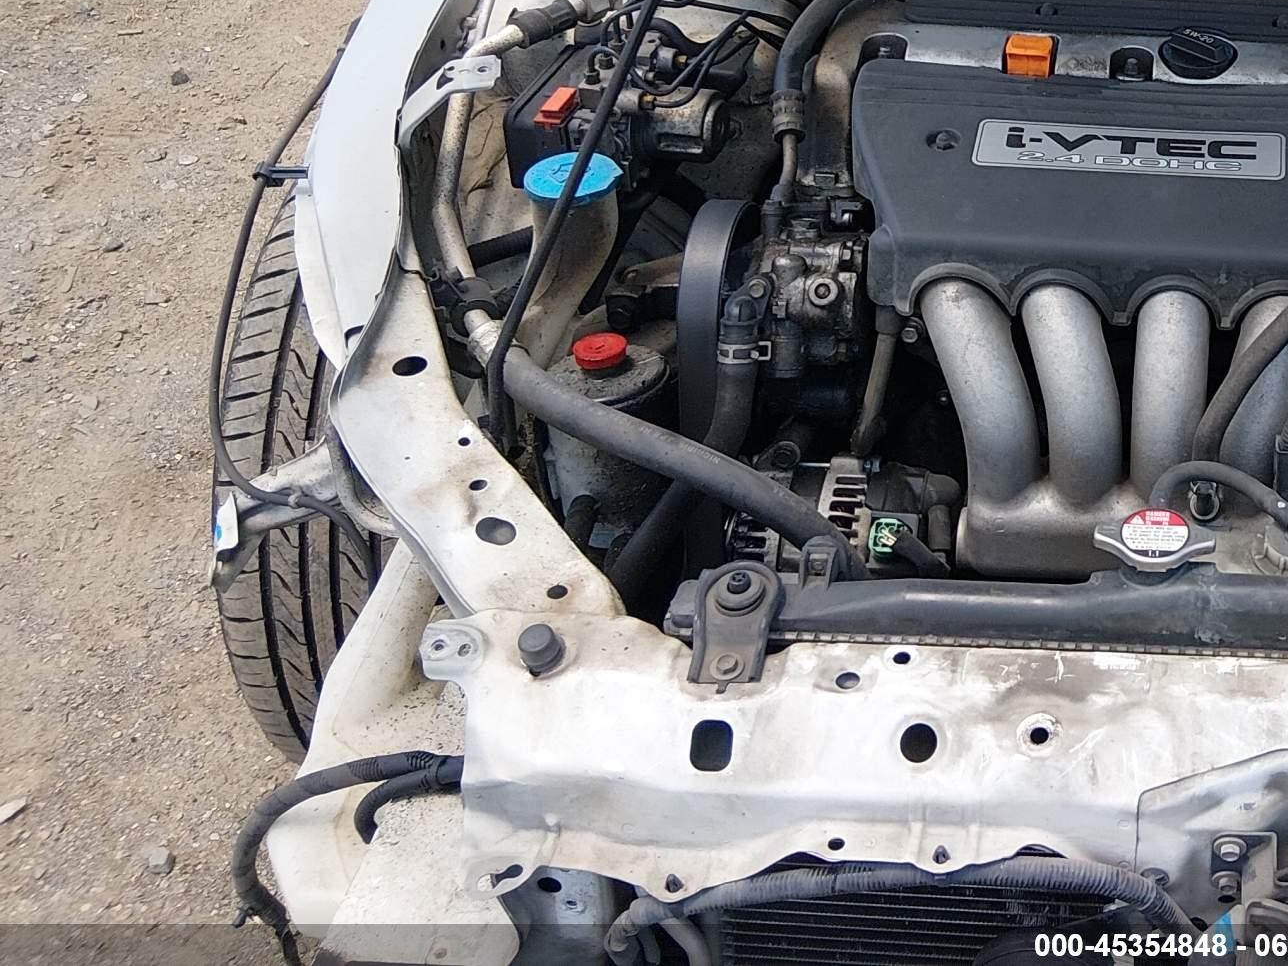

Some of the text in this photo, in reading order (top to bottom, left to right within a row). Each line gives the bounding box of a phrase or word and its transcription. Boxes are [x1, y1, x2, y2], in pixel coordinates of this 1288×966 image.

[1183, 28, 1214, 44] 5W-20
[1005, 126, 1258, 161] i-VTEC
[1016, 150, 1242, 171] 2.4 DOHC
